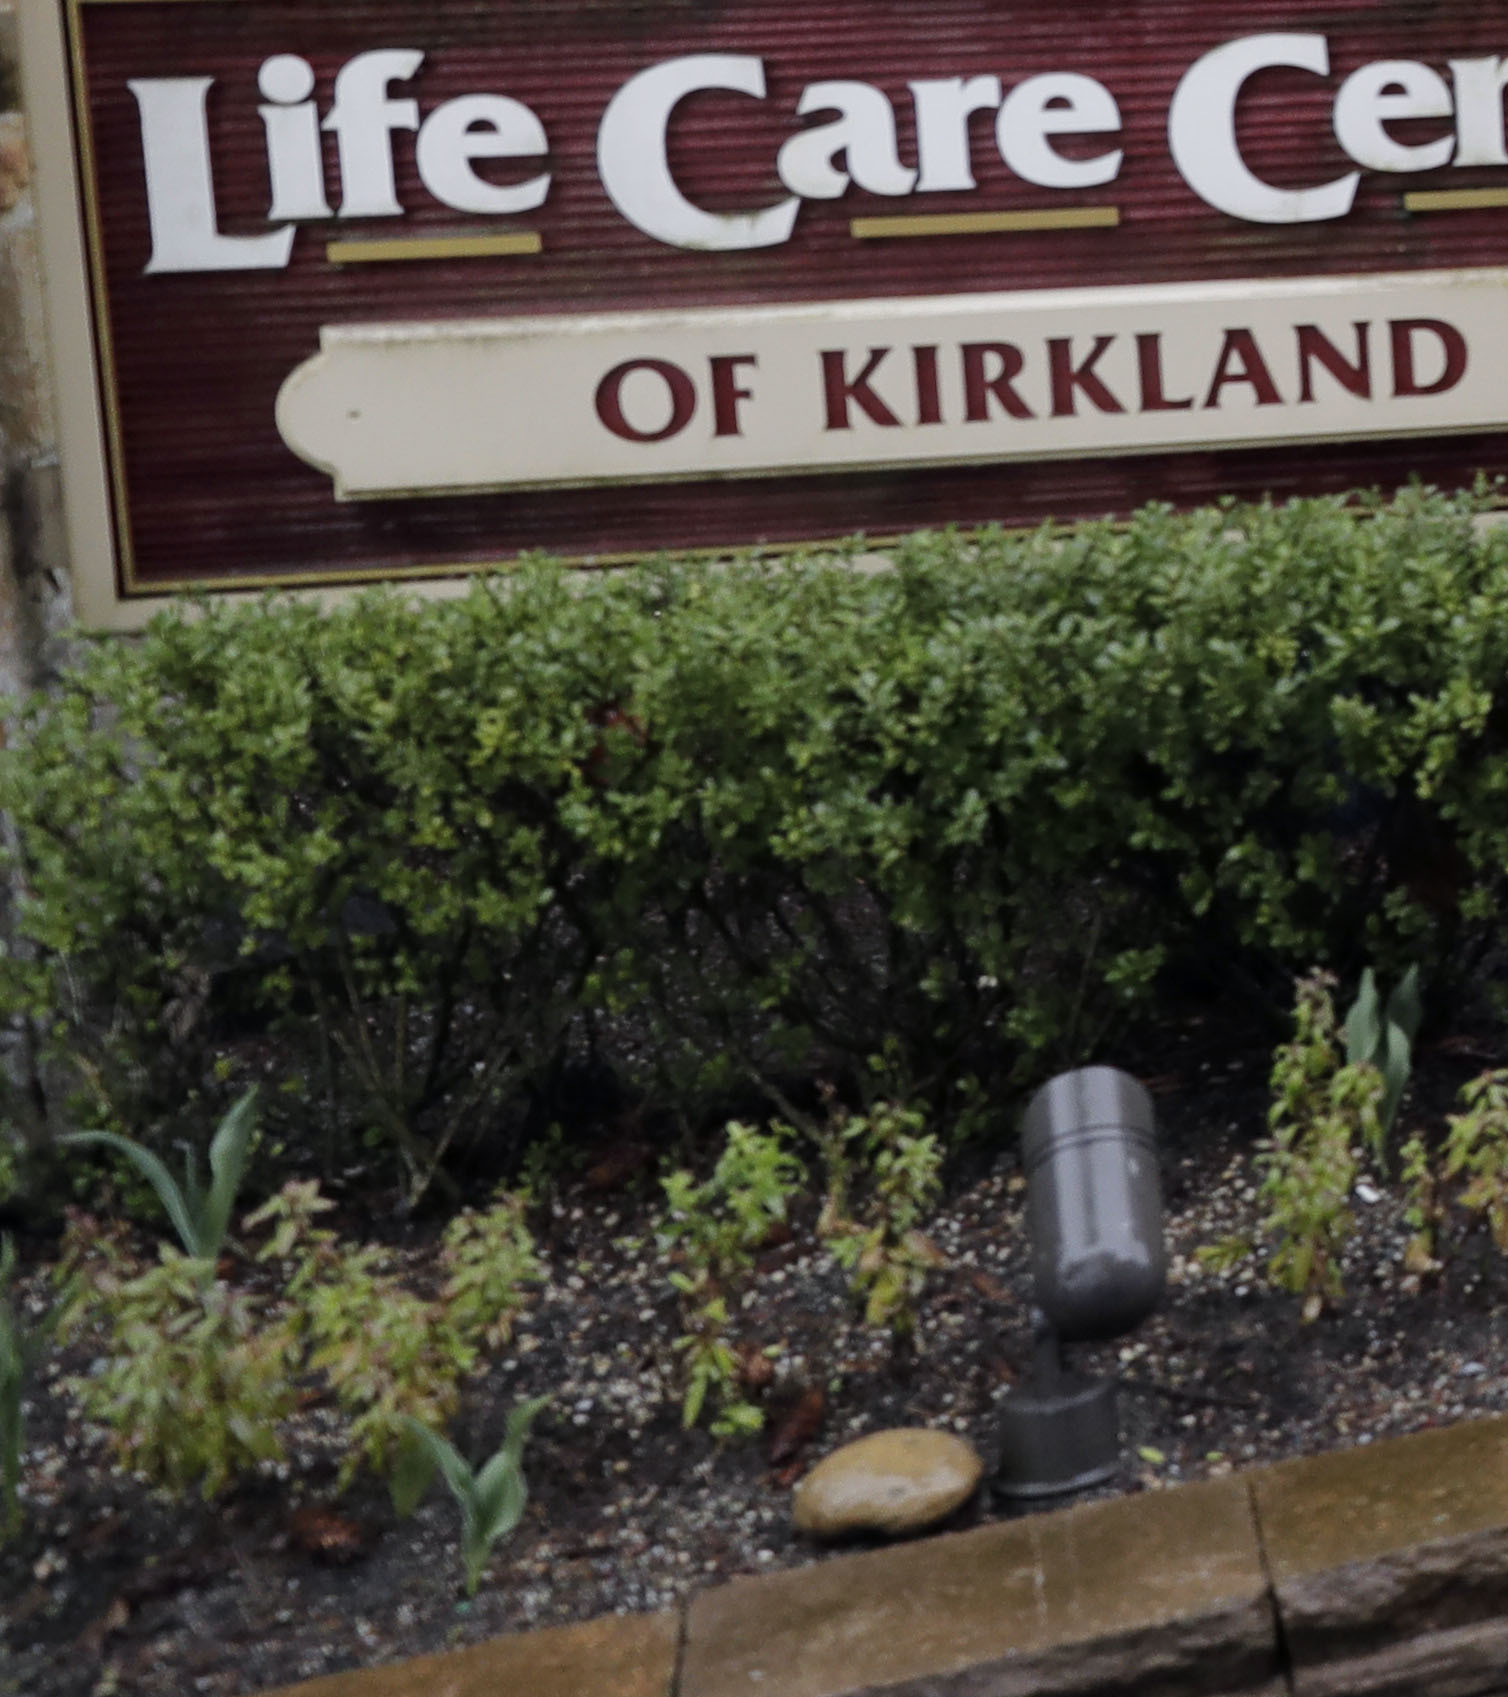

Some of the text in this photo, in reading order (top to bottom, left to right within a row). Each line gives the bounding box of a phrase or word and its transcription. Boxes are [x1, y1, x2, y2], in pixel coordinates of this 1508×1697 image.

[126, 47, 550, 275] Life
[597, 53, 1124, 251] Care
[594, 316, 1470, 443] OF KIRKLAND
